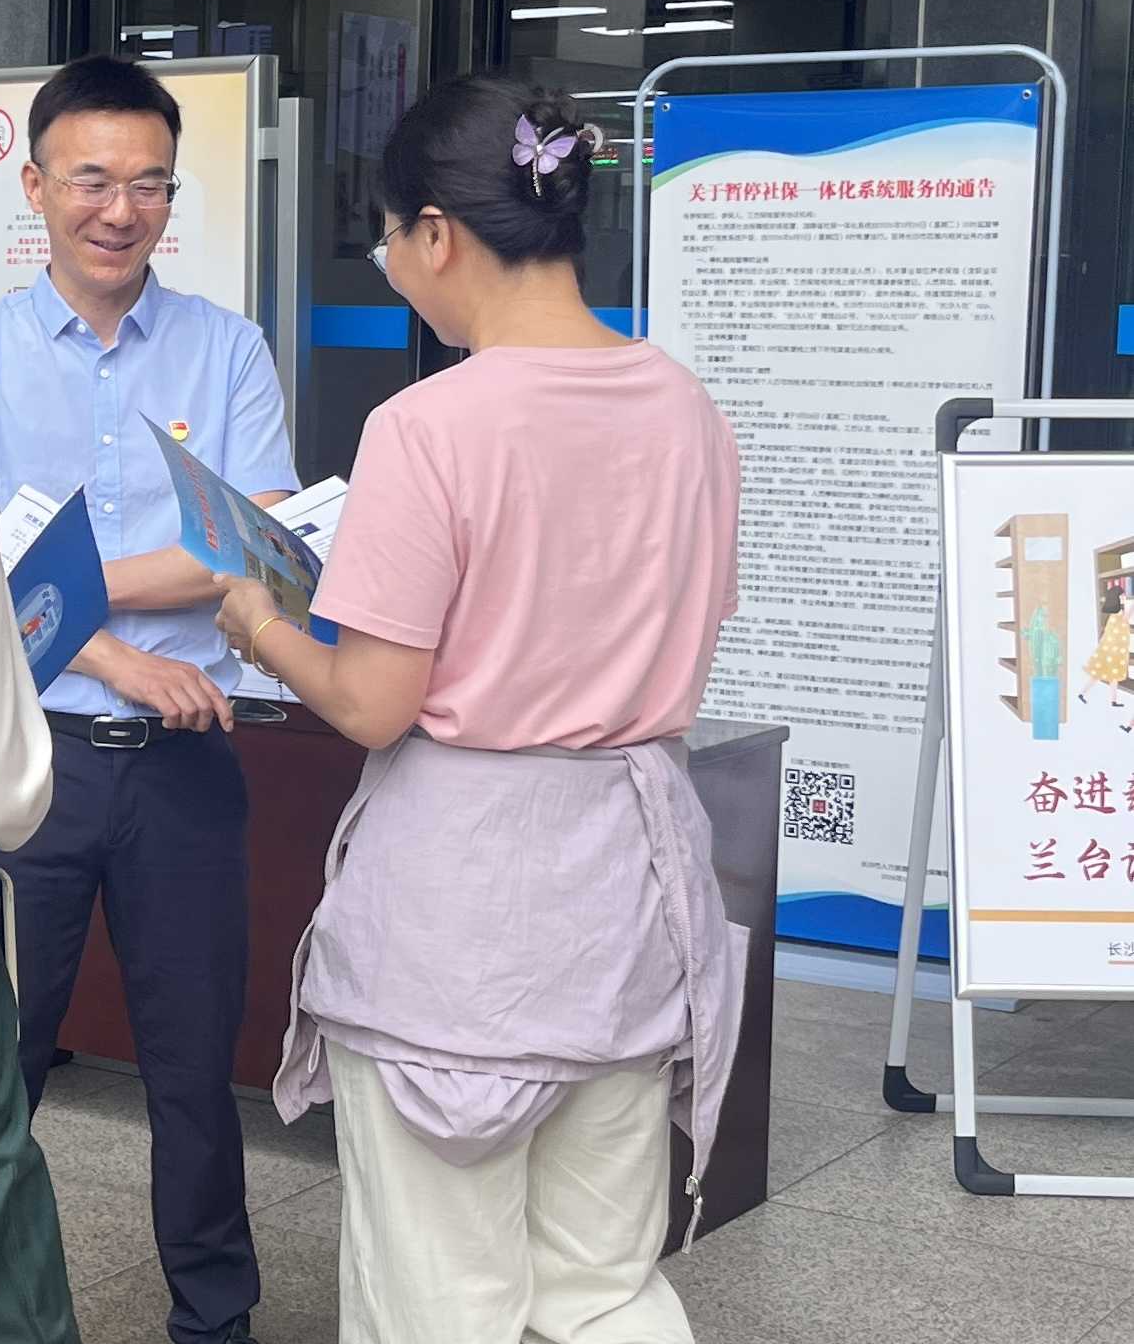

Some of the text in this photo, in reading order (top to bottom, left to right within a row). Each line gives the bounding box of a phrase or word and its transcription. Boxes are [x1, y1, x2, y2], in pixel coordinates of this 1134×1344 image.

[689, 177, 996, 202] 关于暂停社保一体化系统服务的通告
